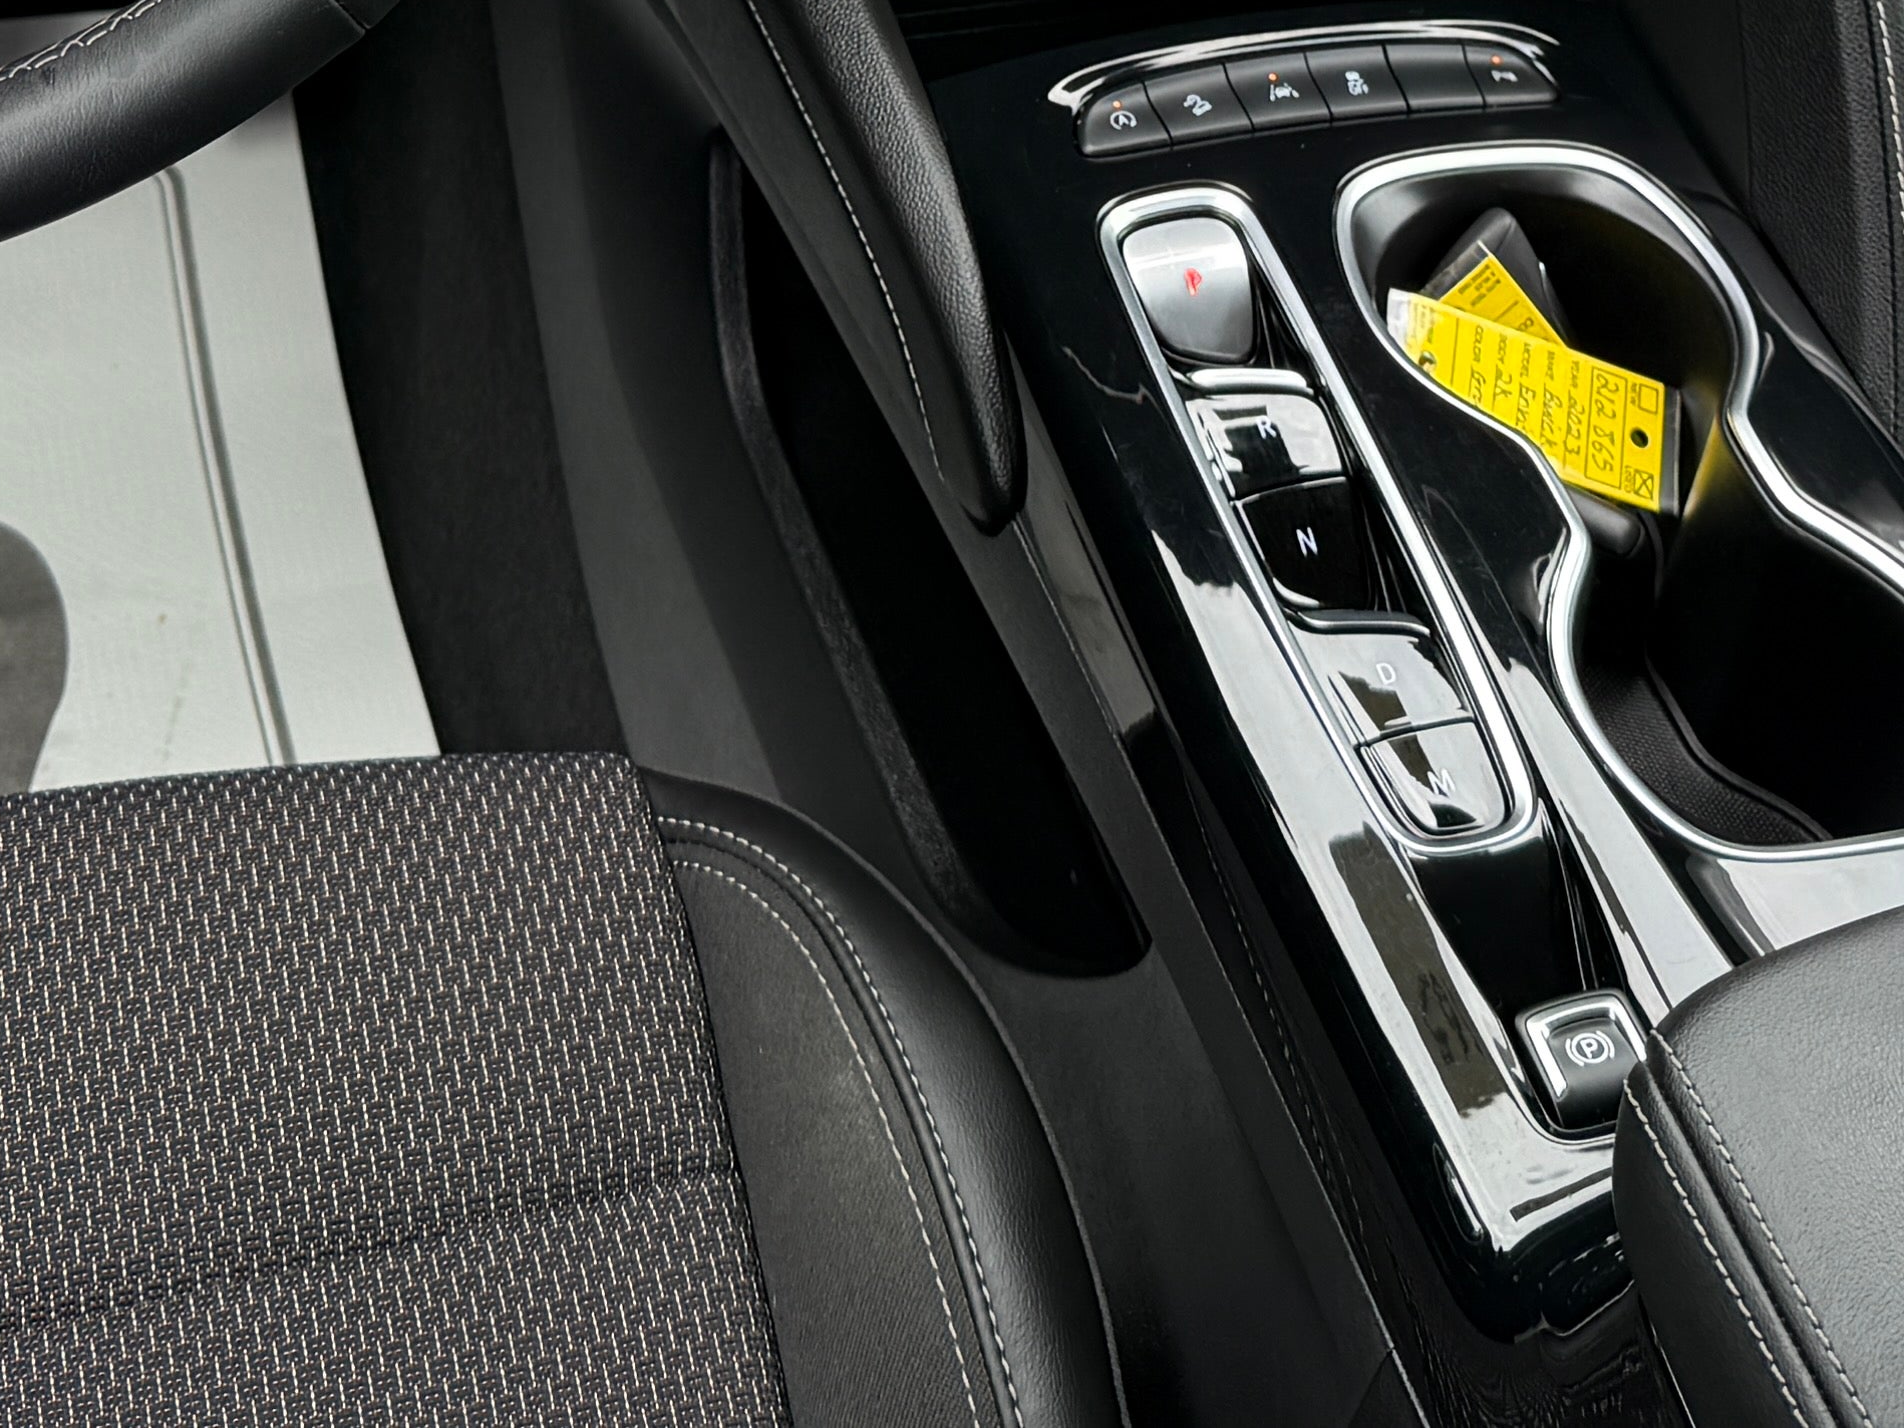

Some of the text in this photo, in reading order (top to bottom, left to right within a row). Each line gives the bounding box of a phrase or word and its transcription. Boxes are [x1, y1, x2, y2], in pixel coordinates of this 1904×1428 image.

[1183, 267, 1203, 297] P
[1256, 417, 1278, 440] R
[1296, 527, 1320, 558] N
[1375, 663, 1398, 687] D
[1428, 769, 1457, 795] M
